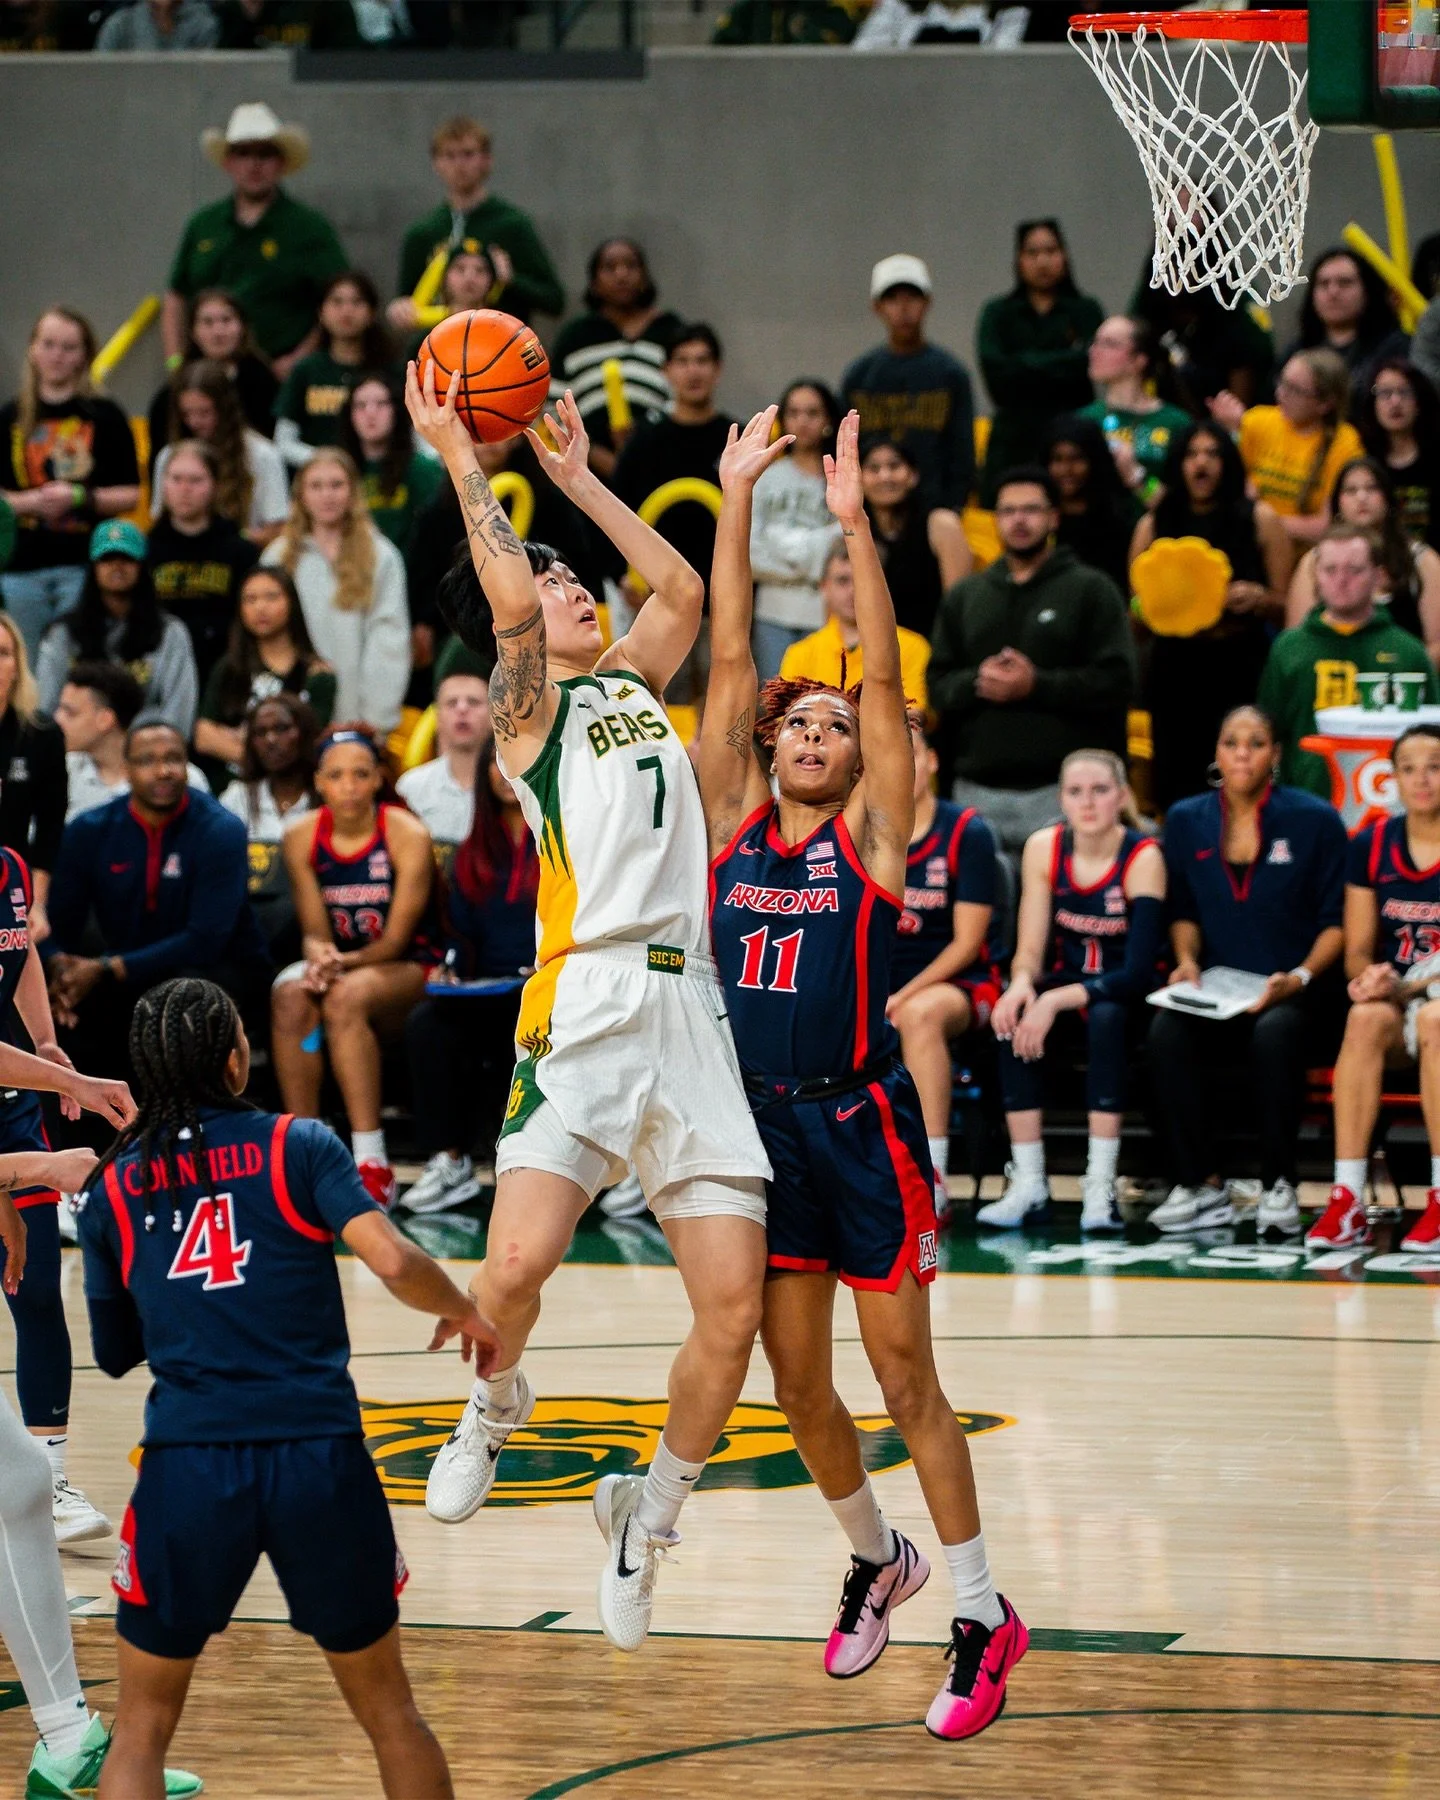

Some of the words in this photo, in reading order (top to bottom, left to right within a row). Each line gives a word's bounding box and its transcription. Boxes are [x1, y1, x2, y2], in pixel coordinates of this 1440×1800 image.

[587, 710, 669, 759] BEAS
[636, 755, 666, 830] 7
[806, 860, 839, 881] XII
[724, 882, 839, 915] ARIZONA
[737, 925, 804, 993] 11
[1081, 937, 1104, 975] 1
[1394, 924, 1440, 965] 13
[167, 1192, 252, 1291] 4
[918, 1229, 937, 1273] A
